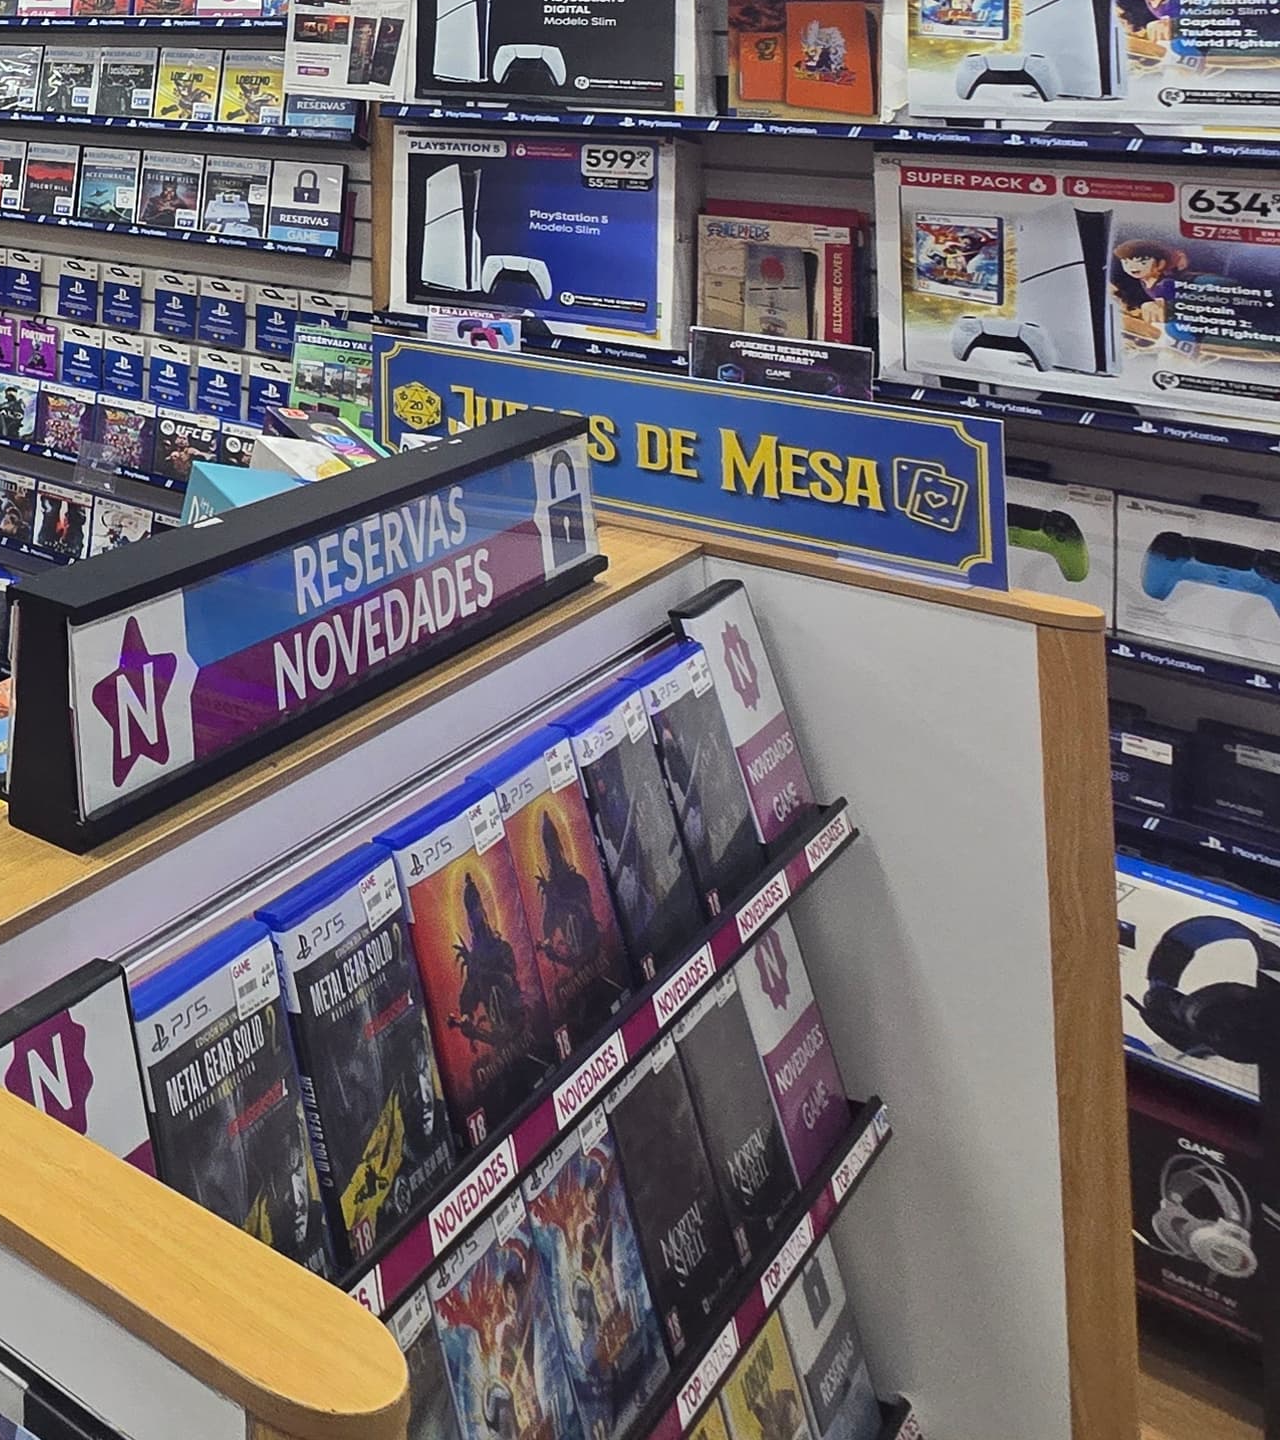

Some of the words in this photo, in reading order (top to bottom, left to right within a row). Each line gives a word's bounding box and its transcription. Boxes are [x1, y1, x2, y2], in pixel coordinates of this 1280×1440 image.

[544, 5, 591, 15] DIGITAL
[1238, 7, 1268, 15] Slim
[544, 16, 586, 27] Modelo
[591, 16, 616, 27] Slim
[1180, 18, 1240, 27] Captain
[236, 75, 270, 86] LOBEZNO
[297, 100, 345, 111] RESERVAS
[410, 139, 491, 154] PLAYSTATION
[493, 143, 500, 153] 5
[917, 132, 970, 142] PlayStation
[1030, 137, 1088, 148] PlayStation
[147, 173, 176, 182] SILENT
[177, 175, 195, 184] HILL
[906, 171, 966, 185] SUPER
[971, 175, 1022, 190] PACK
[280, 214, 329, 227] RESERVAS
[529, 209, 597, 224] PlayStation
[601, 214, 608, 223] 5
[529, 221, 573, 234] Modelo
[575, 224, 601, 236] Slim
[1175, 281, 1261, 297] PlayStation
[1264, 289, 1273, 297] 5
[1175, 302, 1235, 316] Captain
[1176, 323, 1218, 335] World
[766, 369, 791, 378] GAME
[410, 400, 423, 410] 20
[986, 400, 1041, 416] PlayStation
[1164, 426, 1228, 443] PlayStation
[448, 383, 616, 463] JUS
[637, 422, 701, 479] DE
[720, 427, 886, 512] MESA
[293, 485, 467, 615] RESERVAS
[273, 548, 493, 711] NOVEDADES
[1141, 651, 1205, 673] PlayStation
[116, 664, 159, 759] N
[747, 731, 794, 785] NOVEDADES
[511, 779, 534, 802] PS5
[772, 781, 799, 822] GAME
[424, 838, 453, 865] PS5
[808, 819, 845, 864] NOVEDADES
[738, 879, 784, 936] NOVEDADES
[312, 912, 345, 945] PS5
[309, 967, 347, 1017] METAL
[344, 947, 374, 993] GEAR
[370, 930, 393, 977] SOLID
[657, 955, 711, 1015] NOVEDADES
[172, 996, 208, 1038] PS5
[557, 1033, 572, 1056] 18
[166, 1063, 205, 1117] METAL
[204, 1041, 234, 1097] GEAR
[232, 1014, 265, 1068] SOLID
[266, 1004, 281, 1056] 2
[558, 1043, 621, 1118] NOVEDADES
[801, 1083, 831, 1131] GAME
[469, 1116, 487, 1143] 18
[1178, 1137, 1224, 1164] GAME
[433, 1151, 510, 1244] NOVEDADES
[660, 1200, 703, 1269] MORTAL
